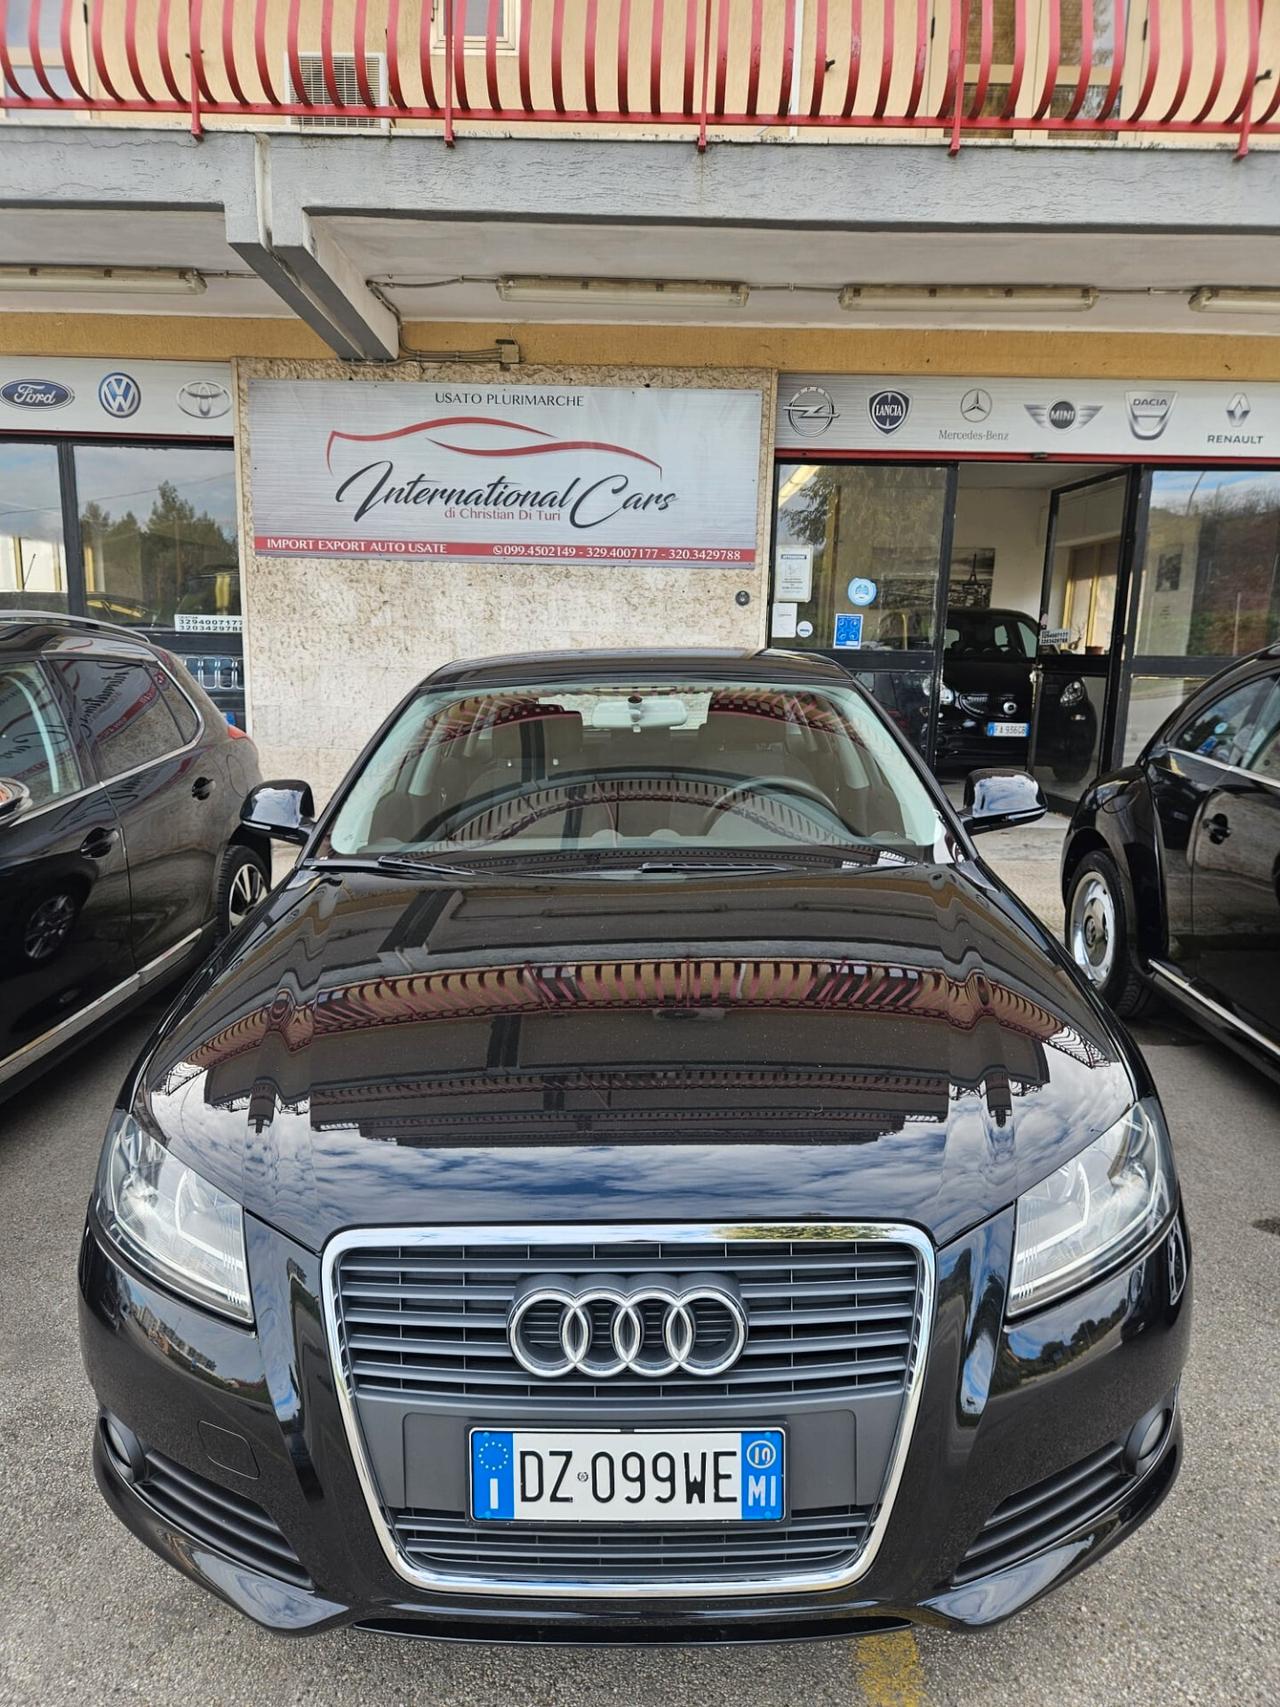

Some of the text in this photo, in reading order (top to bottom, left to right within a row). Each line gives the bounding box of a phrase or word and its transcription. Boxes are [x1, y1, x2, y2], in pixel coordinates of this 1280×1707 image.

[14, 384, 56, 404] Ford
[434, 392, 584, 407] USATO PLURIMARCHE
[875, 404, 903, 417] LANCIA
[1132, 398, 1168, 407] DACIA
[1050, 410, 1075, 421] MINI
[938, 429, 1009, 441] Mercedes-Benz
[1206, 434, 1264, 445] RENAULT
[335, 460, 679, 529] International Cars
[444, 506, 561, 522] di Christian Di Turi
[267, 538, 447, 554] IMPORT EXPORT AUTO USATE
[504, 544, 576, 557] 099.4502149
[586, 547, 658, 559] 329.4007177
[668, 549, 741, 561] 320.3429788
[519, 1450, 738, 1505] DZ 099WE
[747, 1475, 777, 1507] MI
